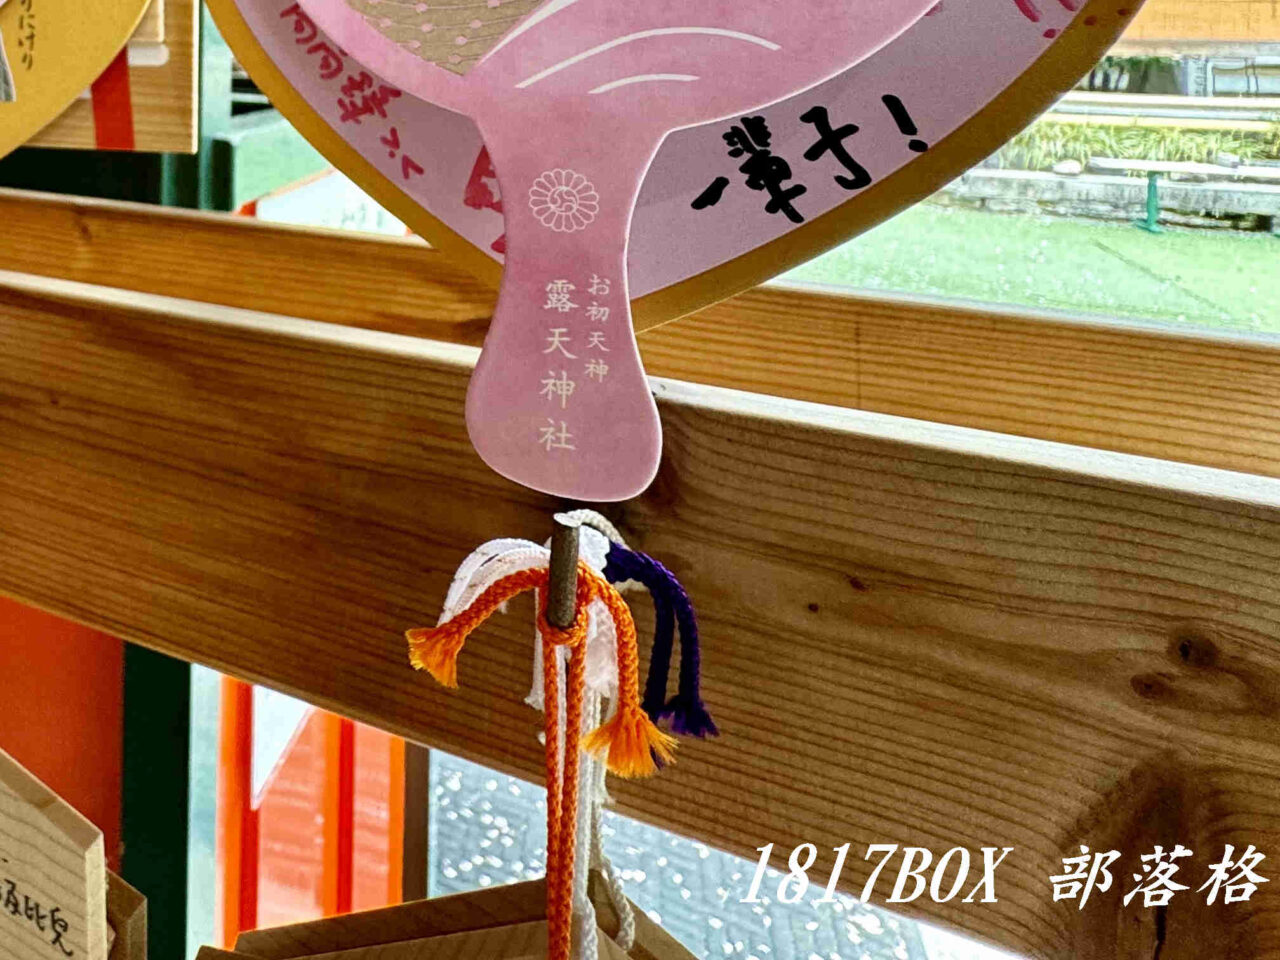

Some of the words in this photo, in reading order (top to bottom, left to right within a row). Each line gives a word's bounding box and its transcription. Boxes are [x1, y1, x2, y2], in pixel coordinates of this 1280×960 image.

[538, 279, 579, 452] 露天神社
[584, 273, 611, 384] お初天神
